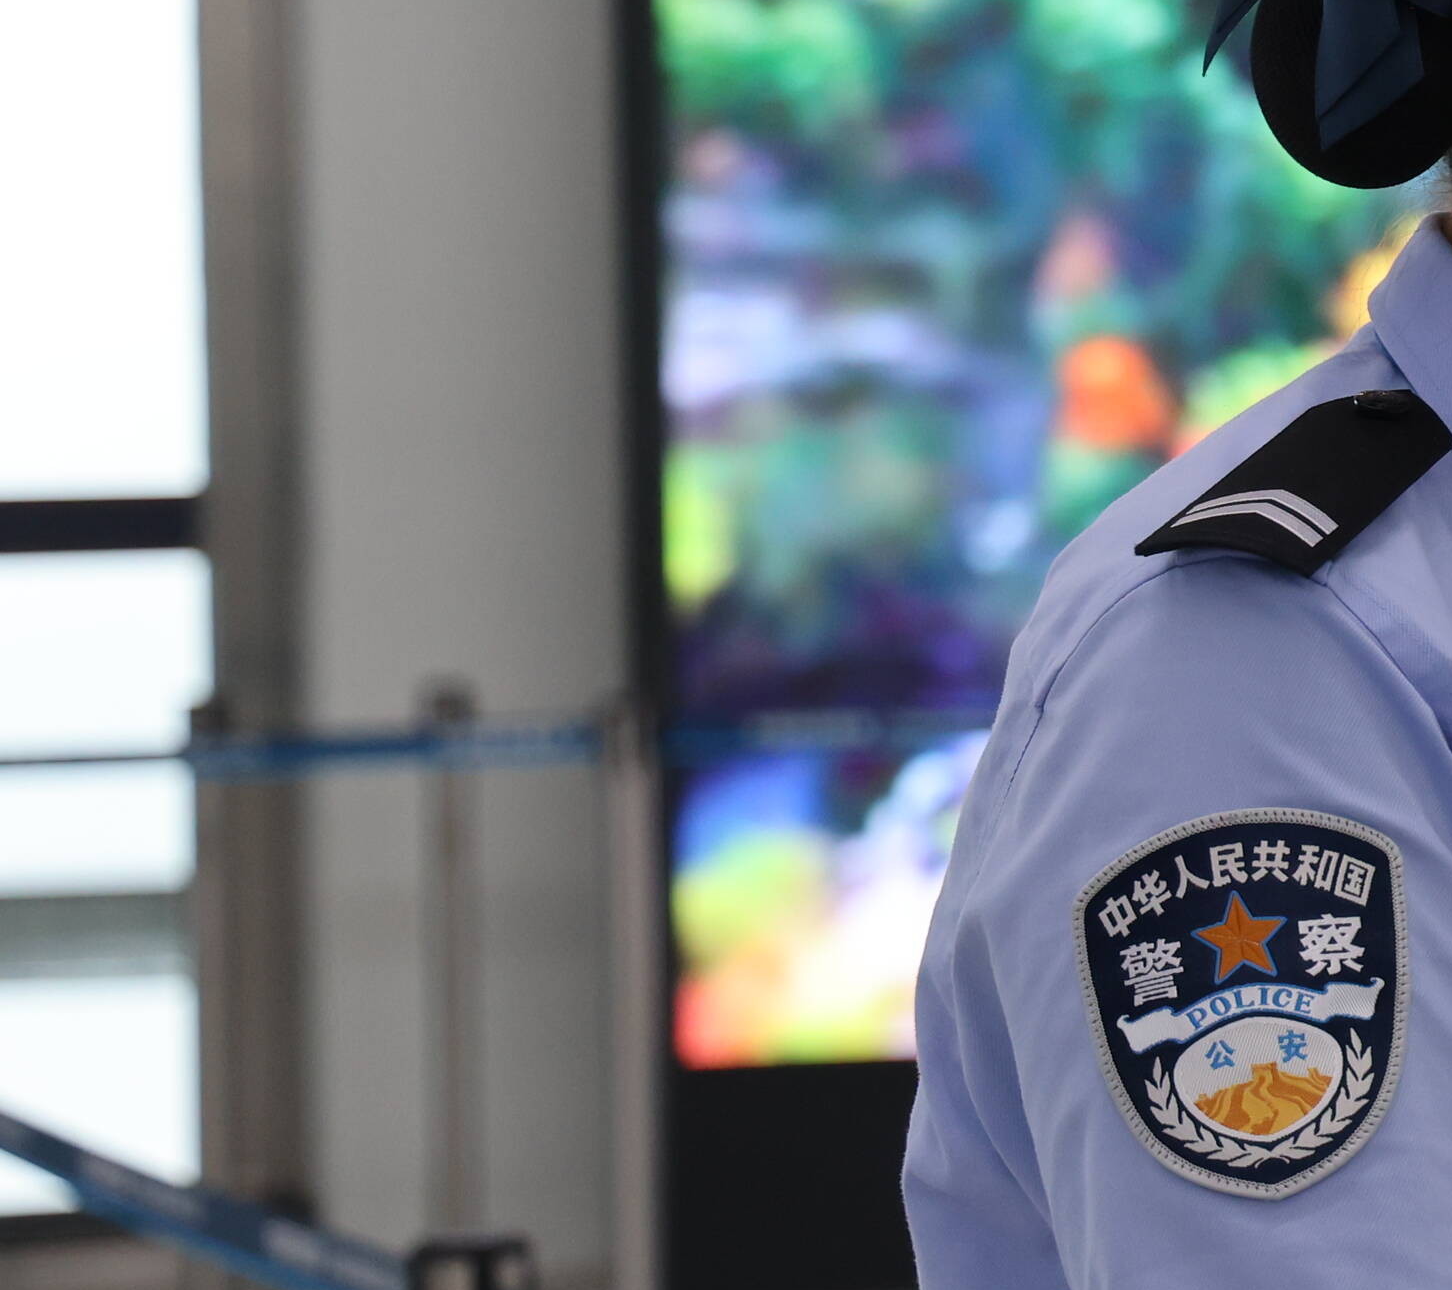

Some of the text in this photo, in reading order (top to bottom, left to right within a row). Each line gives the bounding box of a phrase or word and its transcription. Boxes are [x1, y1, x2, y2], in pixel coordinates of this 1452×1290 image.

[1098, 840, 1375, 938] 中华人民共和国
[1120, 913, 1365, 1005] 警察
[1186, 986, 1316, 1030] POLICE
[1204, 1030, 1309, 1071] 公安
